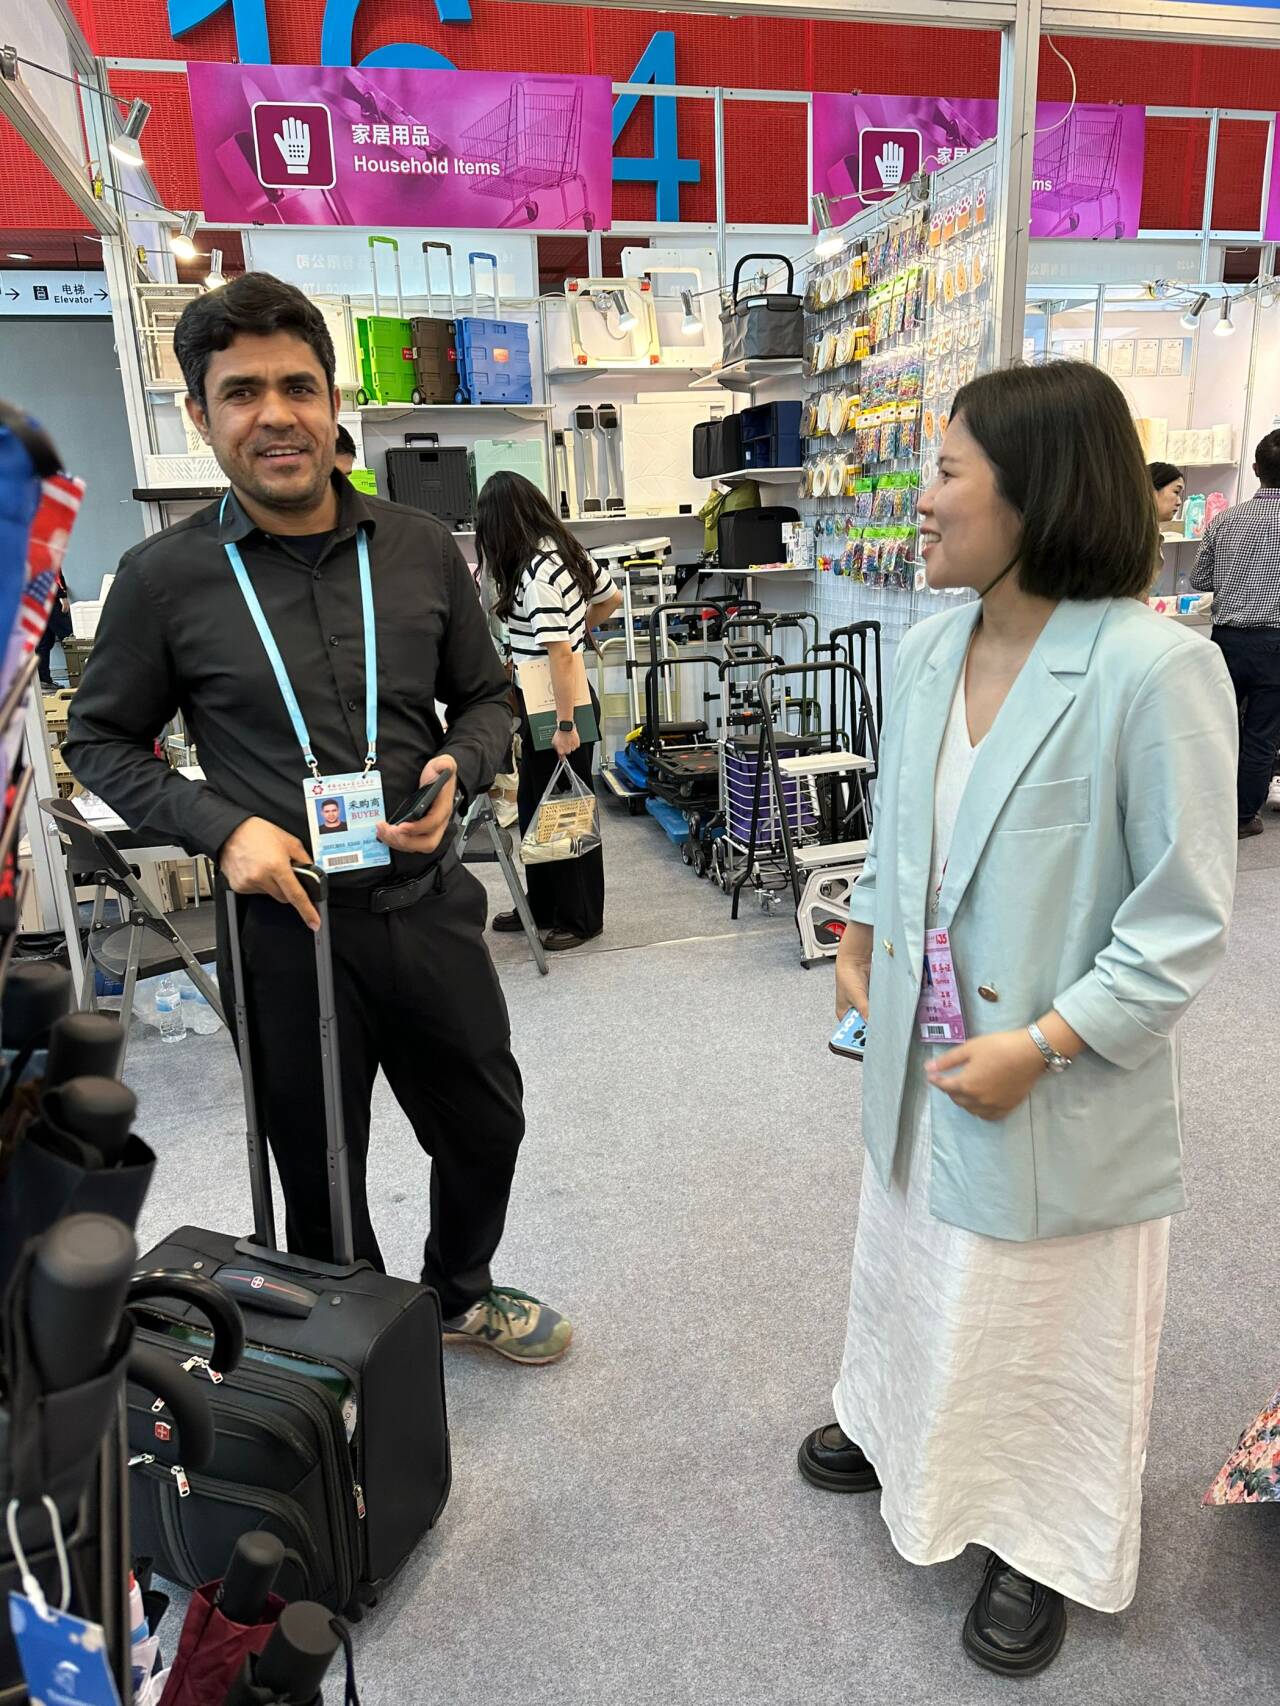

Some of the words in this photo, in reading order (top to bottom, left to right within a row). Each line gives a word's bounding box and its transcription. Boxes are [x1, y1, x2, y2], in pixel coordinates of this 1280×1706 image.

[351, 123, 430, 146] 家居用品
[354, 155, 449, 175] Household
[454, 158, 501, 175] Items
[62, 284, 85, 295] 电梯
[54, 295, 93, 304] Elevator
[351, 809, 380, 820] BUYER
